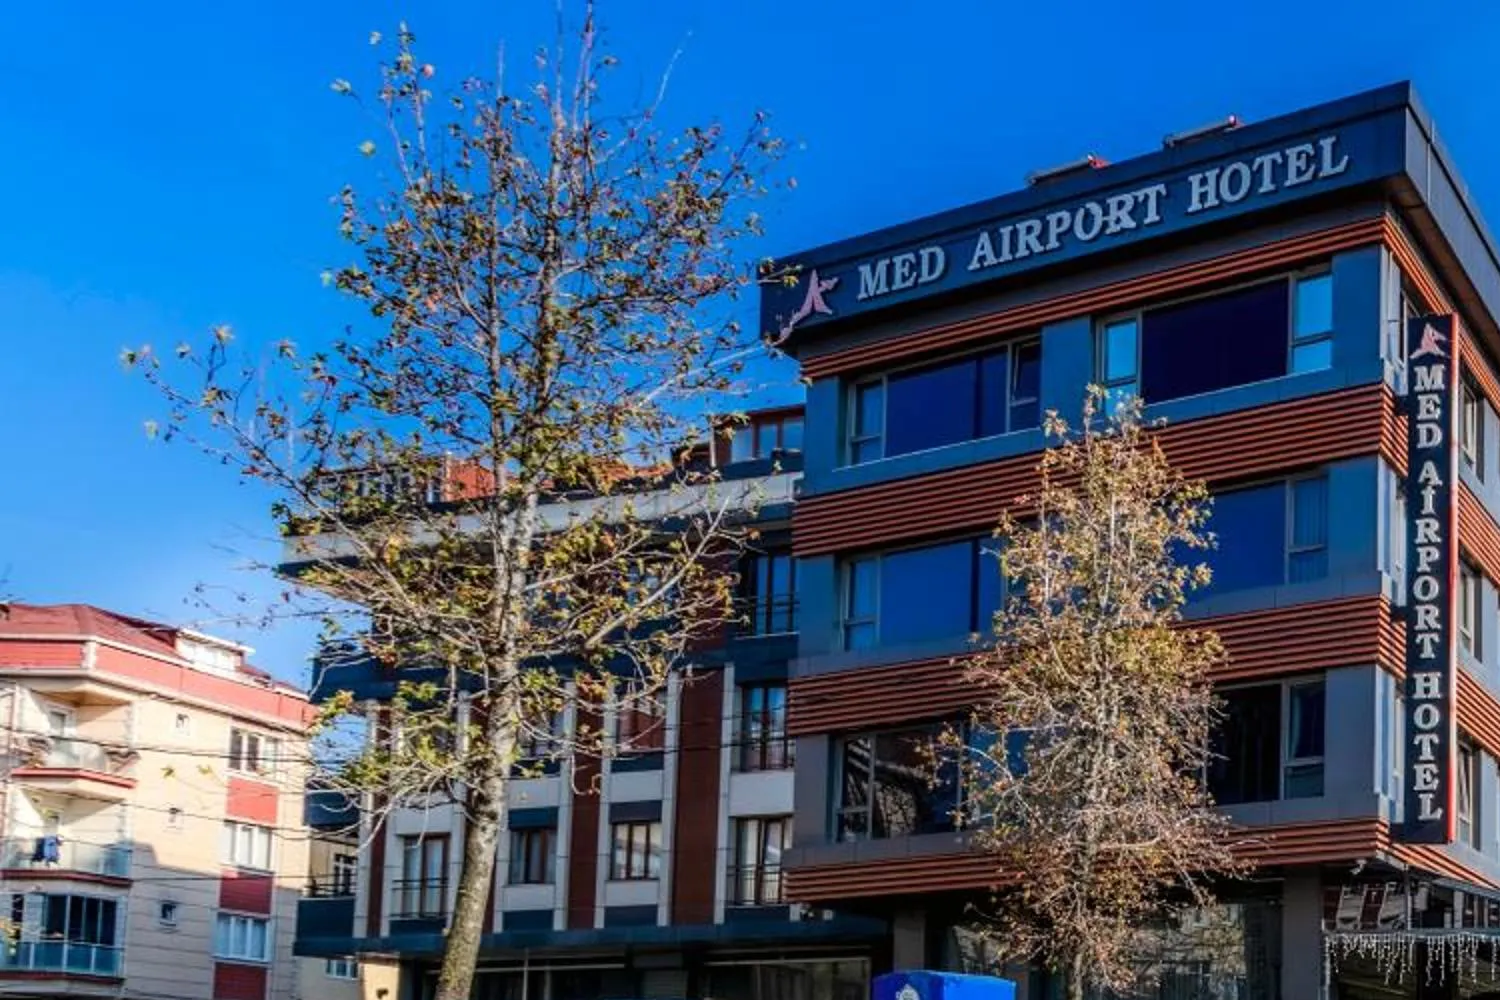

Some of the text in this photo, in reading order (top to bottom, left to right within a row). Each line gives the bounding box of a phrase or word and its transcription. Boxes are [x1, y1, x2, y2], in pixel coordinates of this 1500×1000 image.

[856, 136, 1349, 300] MED AIRPORT HOTEL
[1412, 363, 1446, 821] MED AIRPORT HOTEL
